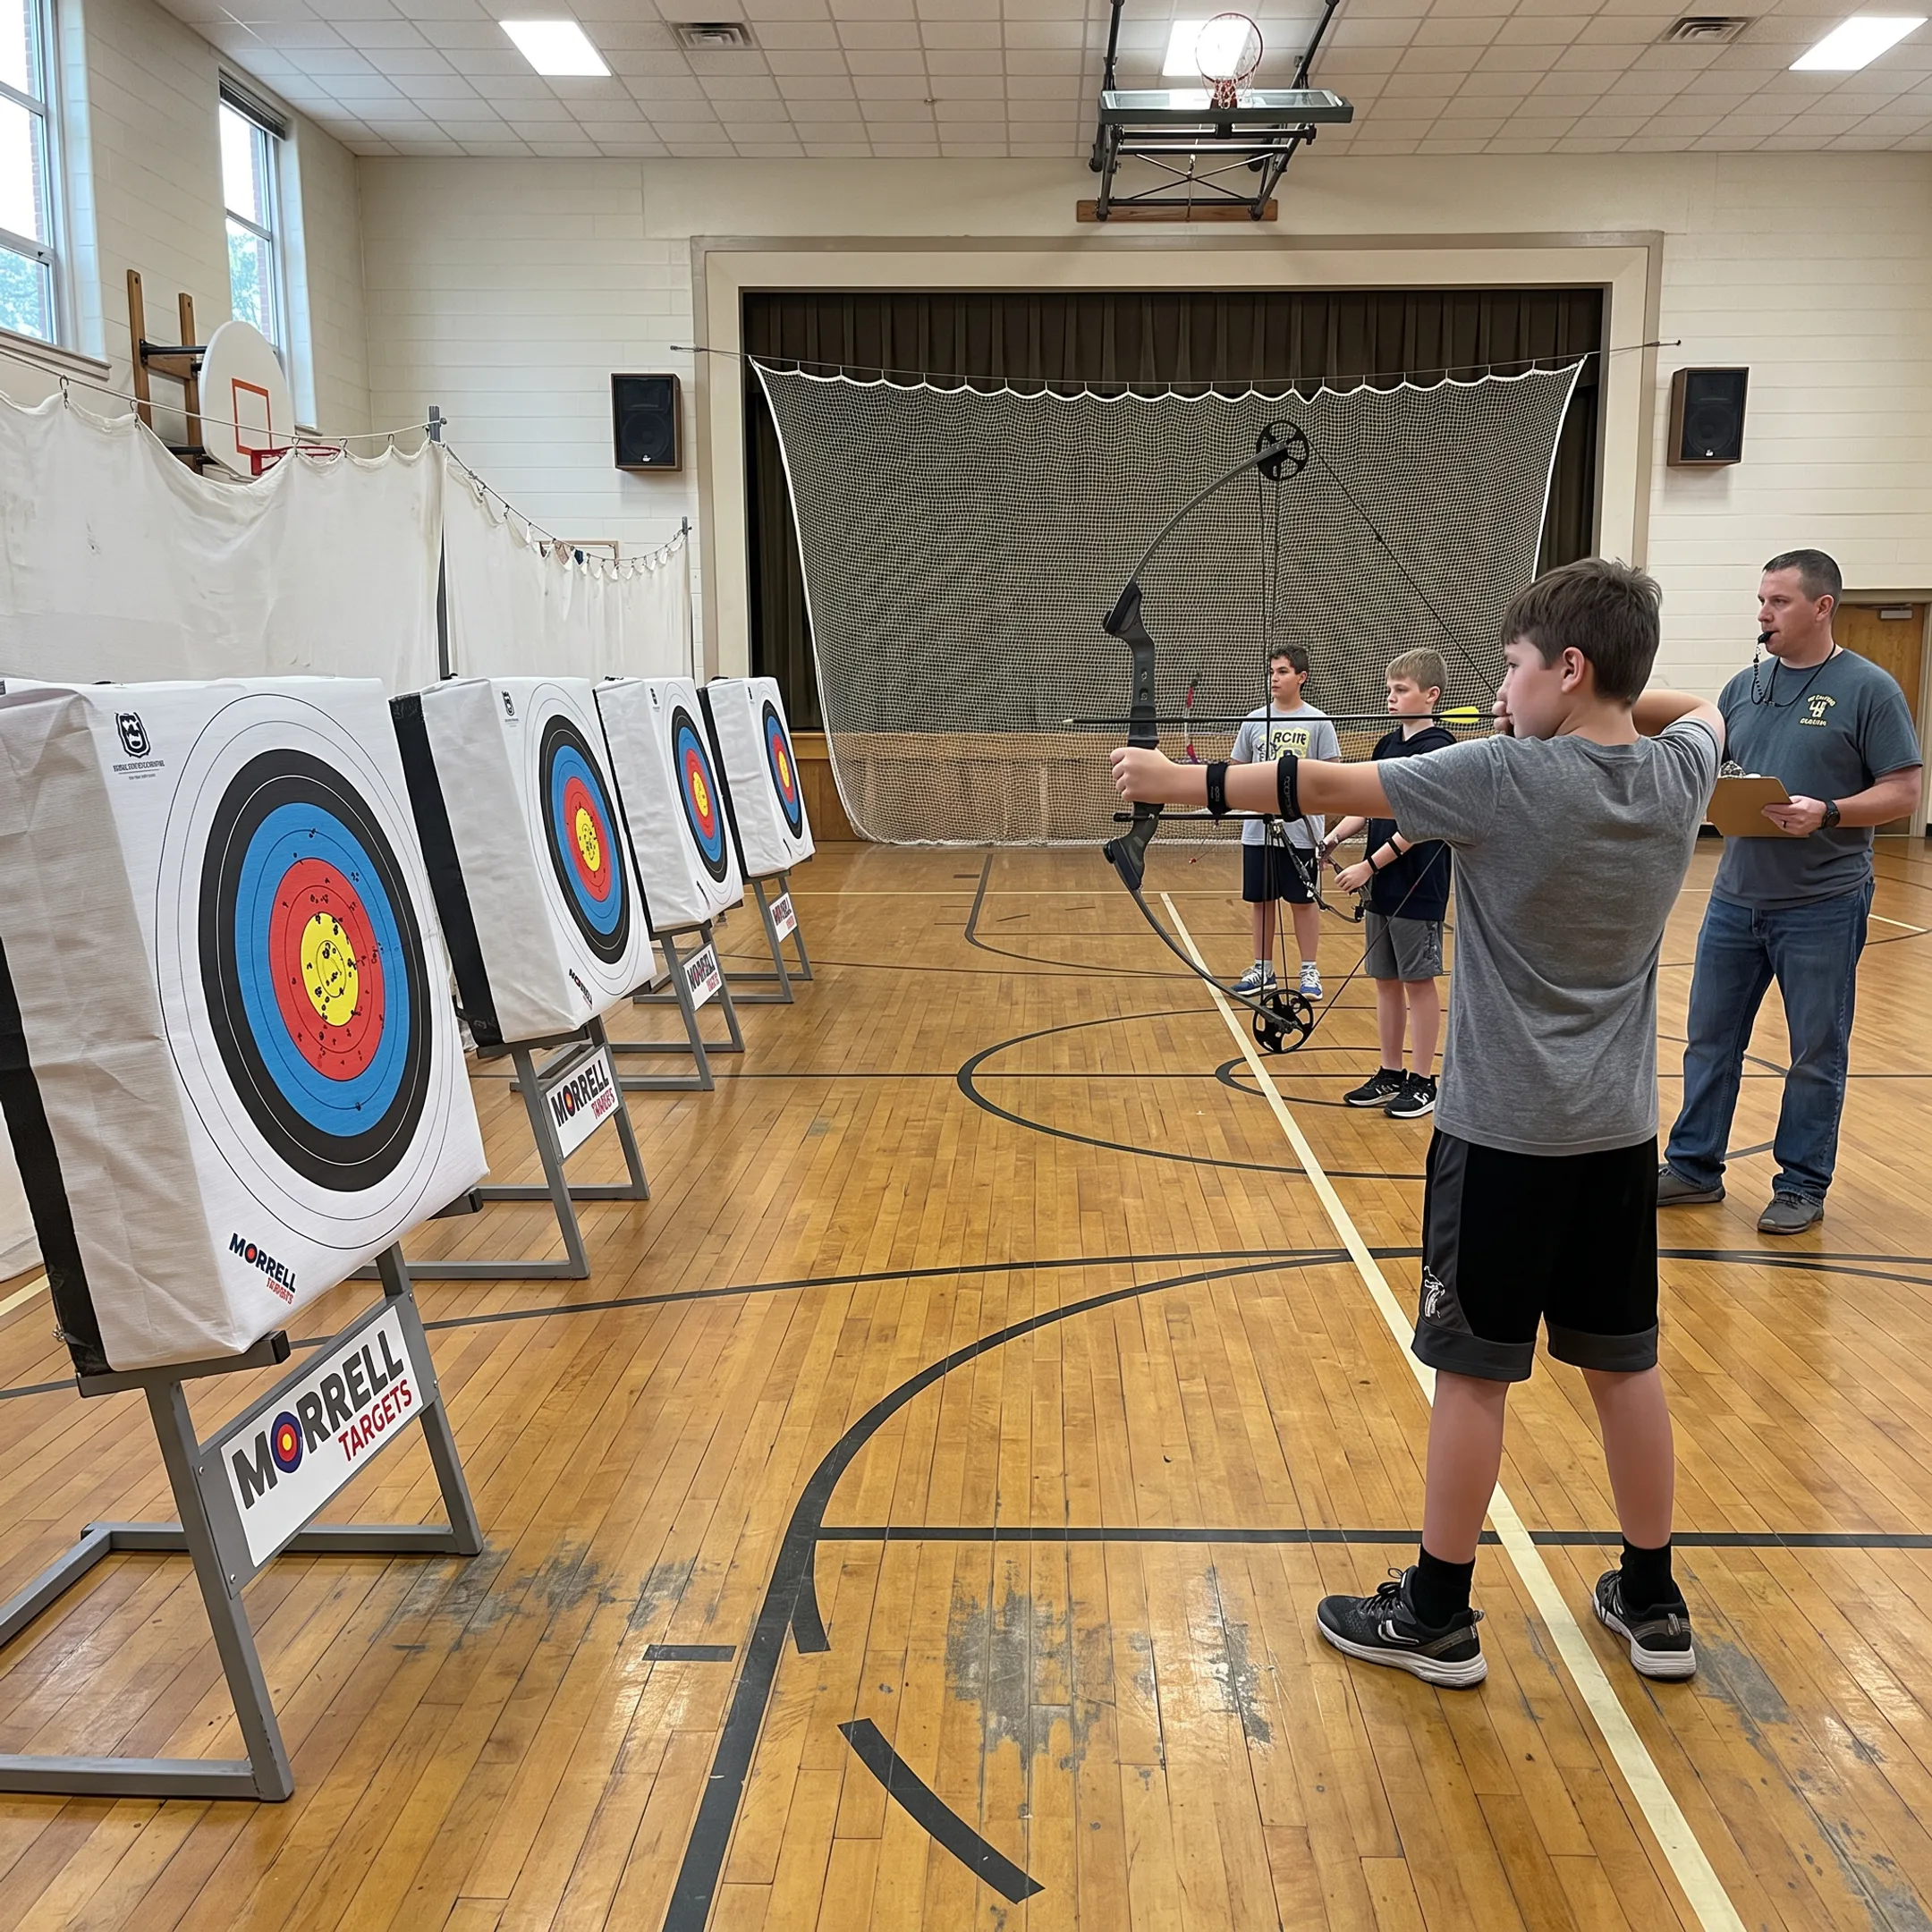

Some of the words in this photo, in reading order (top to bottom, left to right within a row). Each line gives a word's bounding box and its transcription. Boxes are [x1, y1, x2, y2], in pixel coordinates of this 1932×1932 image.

[550, 1059, 609, 1127] MORRELL
[229, 1233, 296, 1293] MORRELL
[232, 1330, 404, 1510] MORRELL
[338, 1379, 412, 1462] TARGETS
